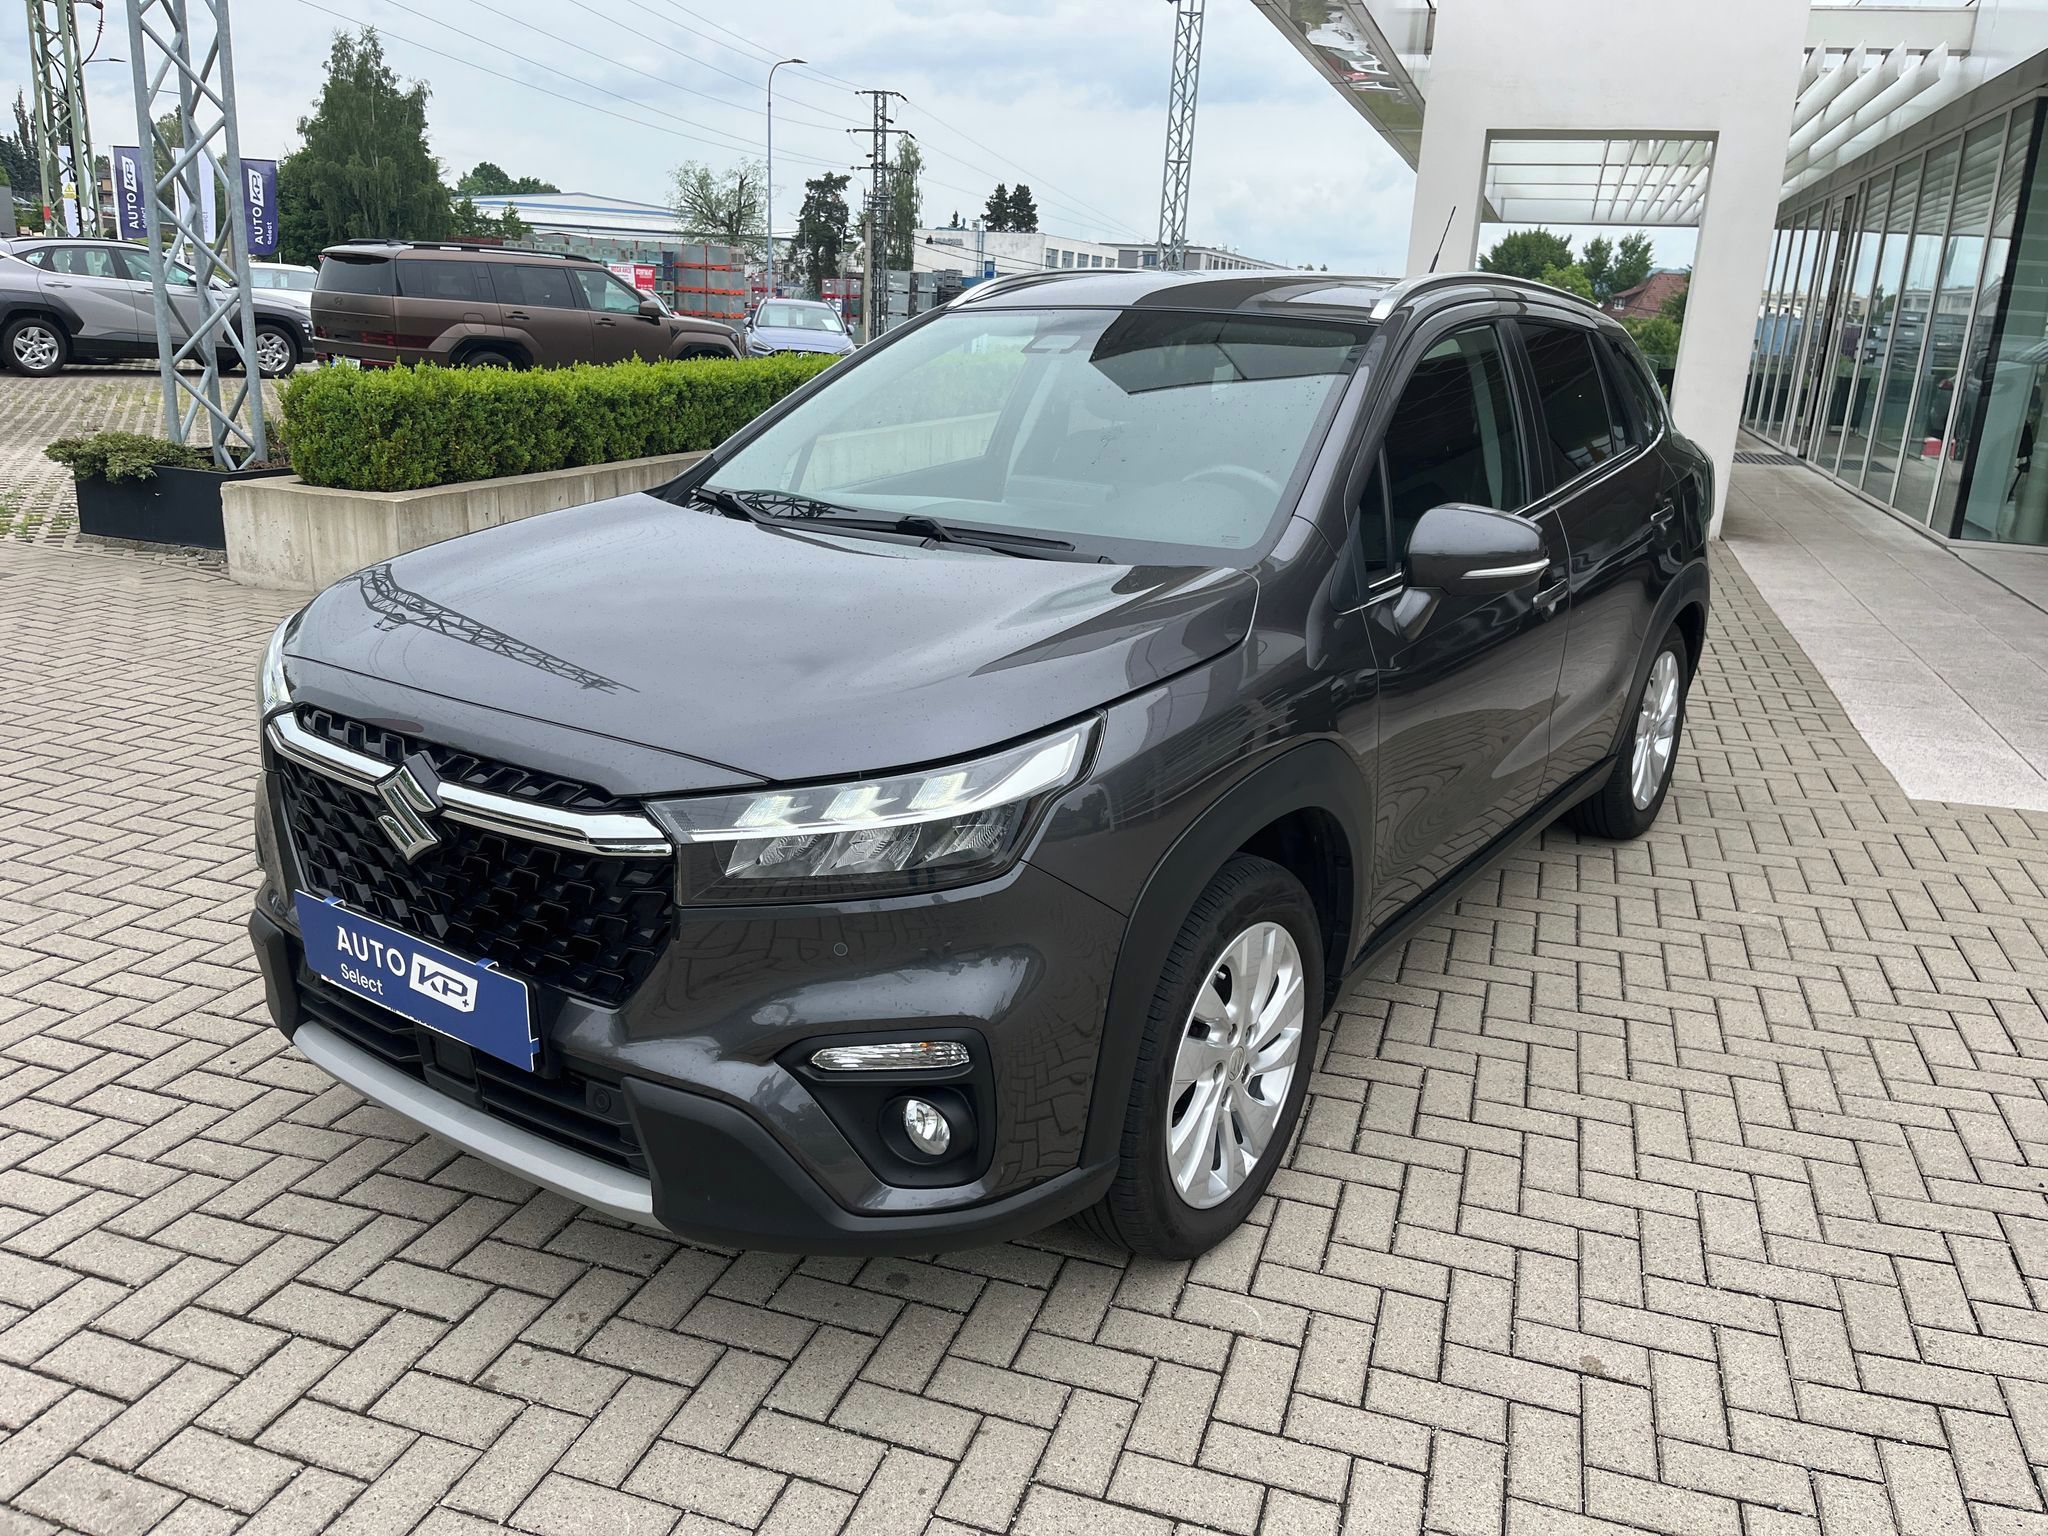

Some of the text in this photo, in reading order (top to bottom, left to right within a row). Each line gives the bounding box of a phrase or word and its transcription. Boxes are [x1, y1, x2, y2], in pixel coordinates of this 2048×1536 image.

[126, 192, 139, 229] AUTO
[252, 206, 264, 245] AUTO
[337, 926, 406, 977] AUTO
[340, 963, 384, 996] Select
